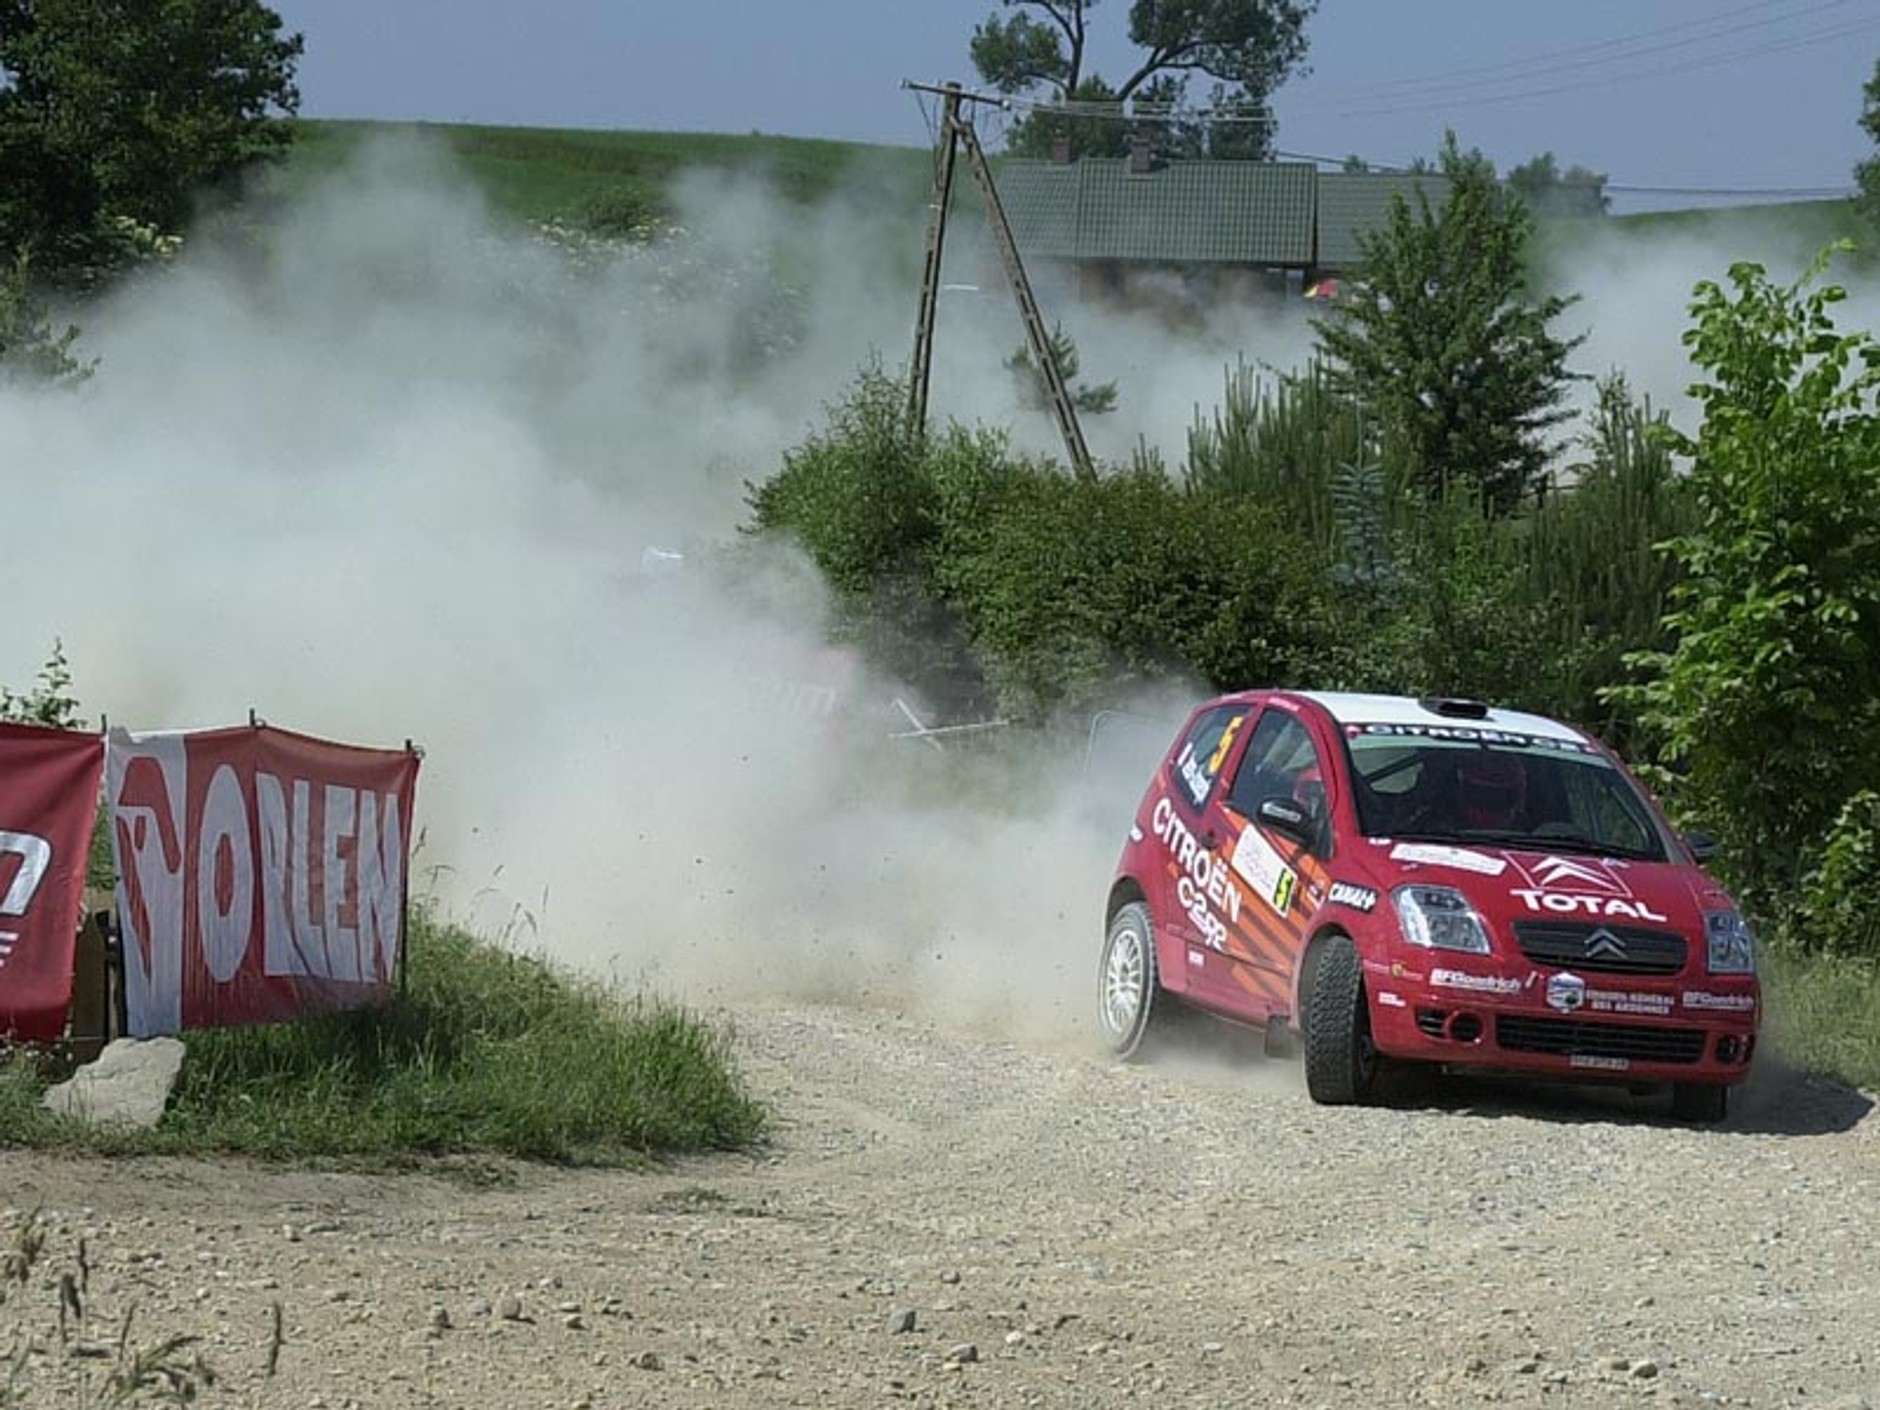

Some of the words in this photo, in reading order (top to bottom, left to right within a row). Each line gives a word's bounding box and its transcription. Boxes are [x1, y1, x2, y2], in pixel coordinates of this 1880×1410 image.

[199, 763, 401, 985] ORLEN
[1152, 798, 1242, 923] CITROËN
[1509, 888, 1668, 923] TOTAL
[1429, 968, 1522, 993] BFGoodrich
